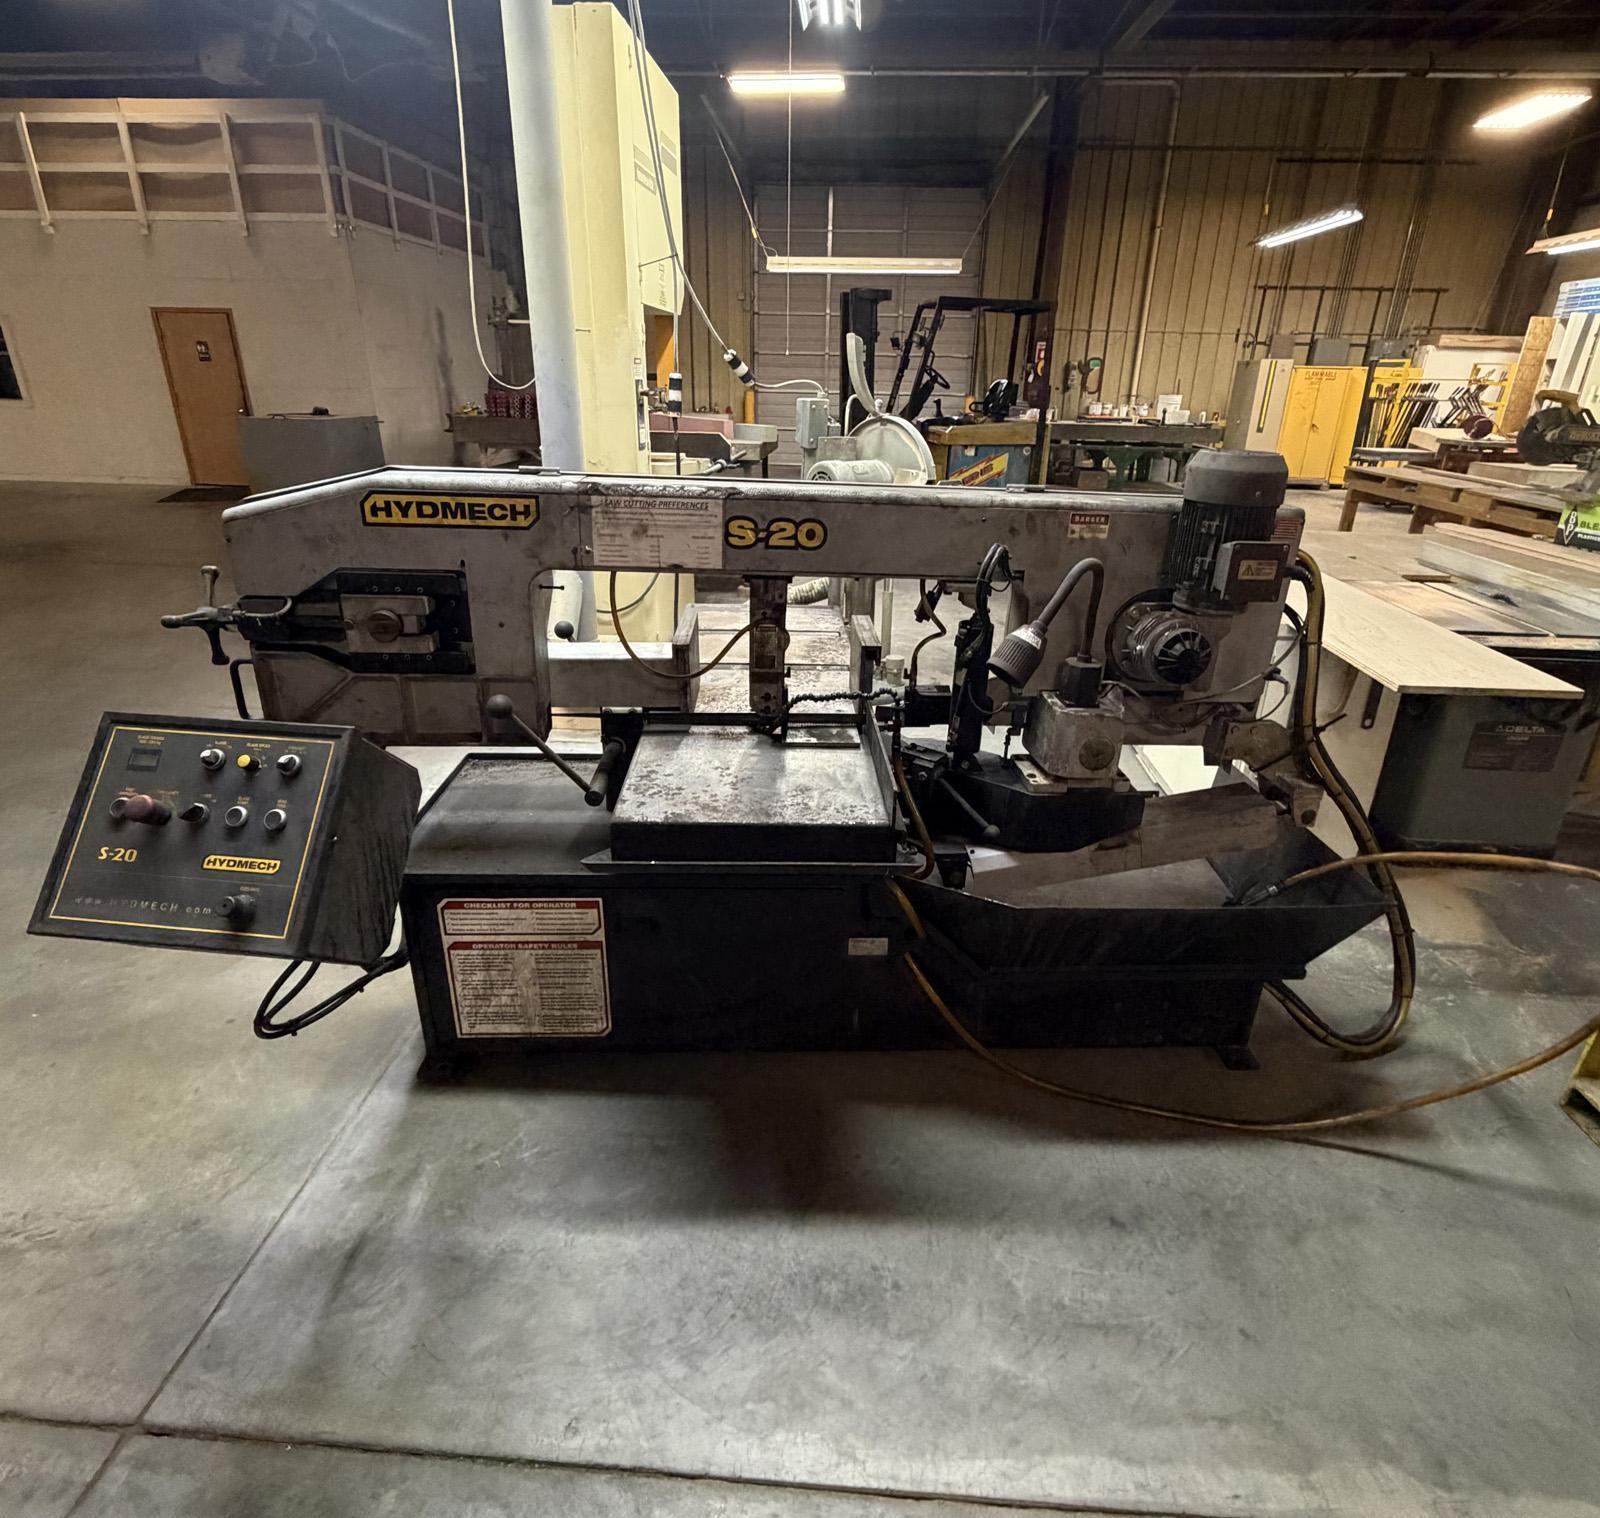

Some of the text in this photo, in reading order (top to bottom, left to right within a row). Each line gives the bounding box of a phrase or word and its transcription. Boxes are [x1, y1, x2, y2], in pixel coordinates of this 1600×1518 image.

[369, 500, 531, 522] HYDMECH
[623, 499, 657, 509] CUTTING
[725, 517, 826, 549] S-20
[98, 846, 138, 863] S-20
[205, 857, 278, 871] HYDMECH
